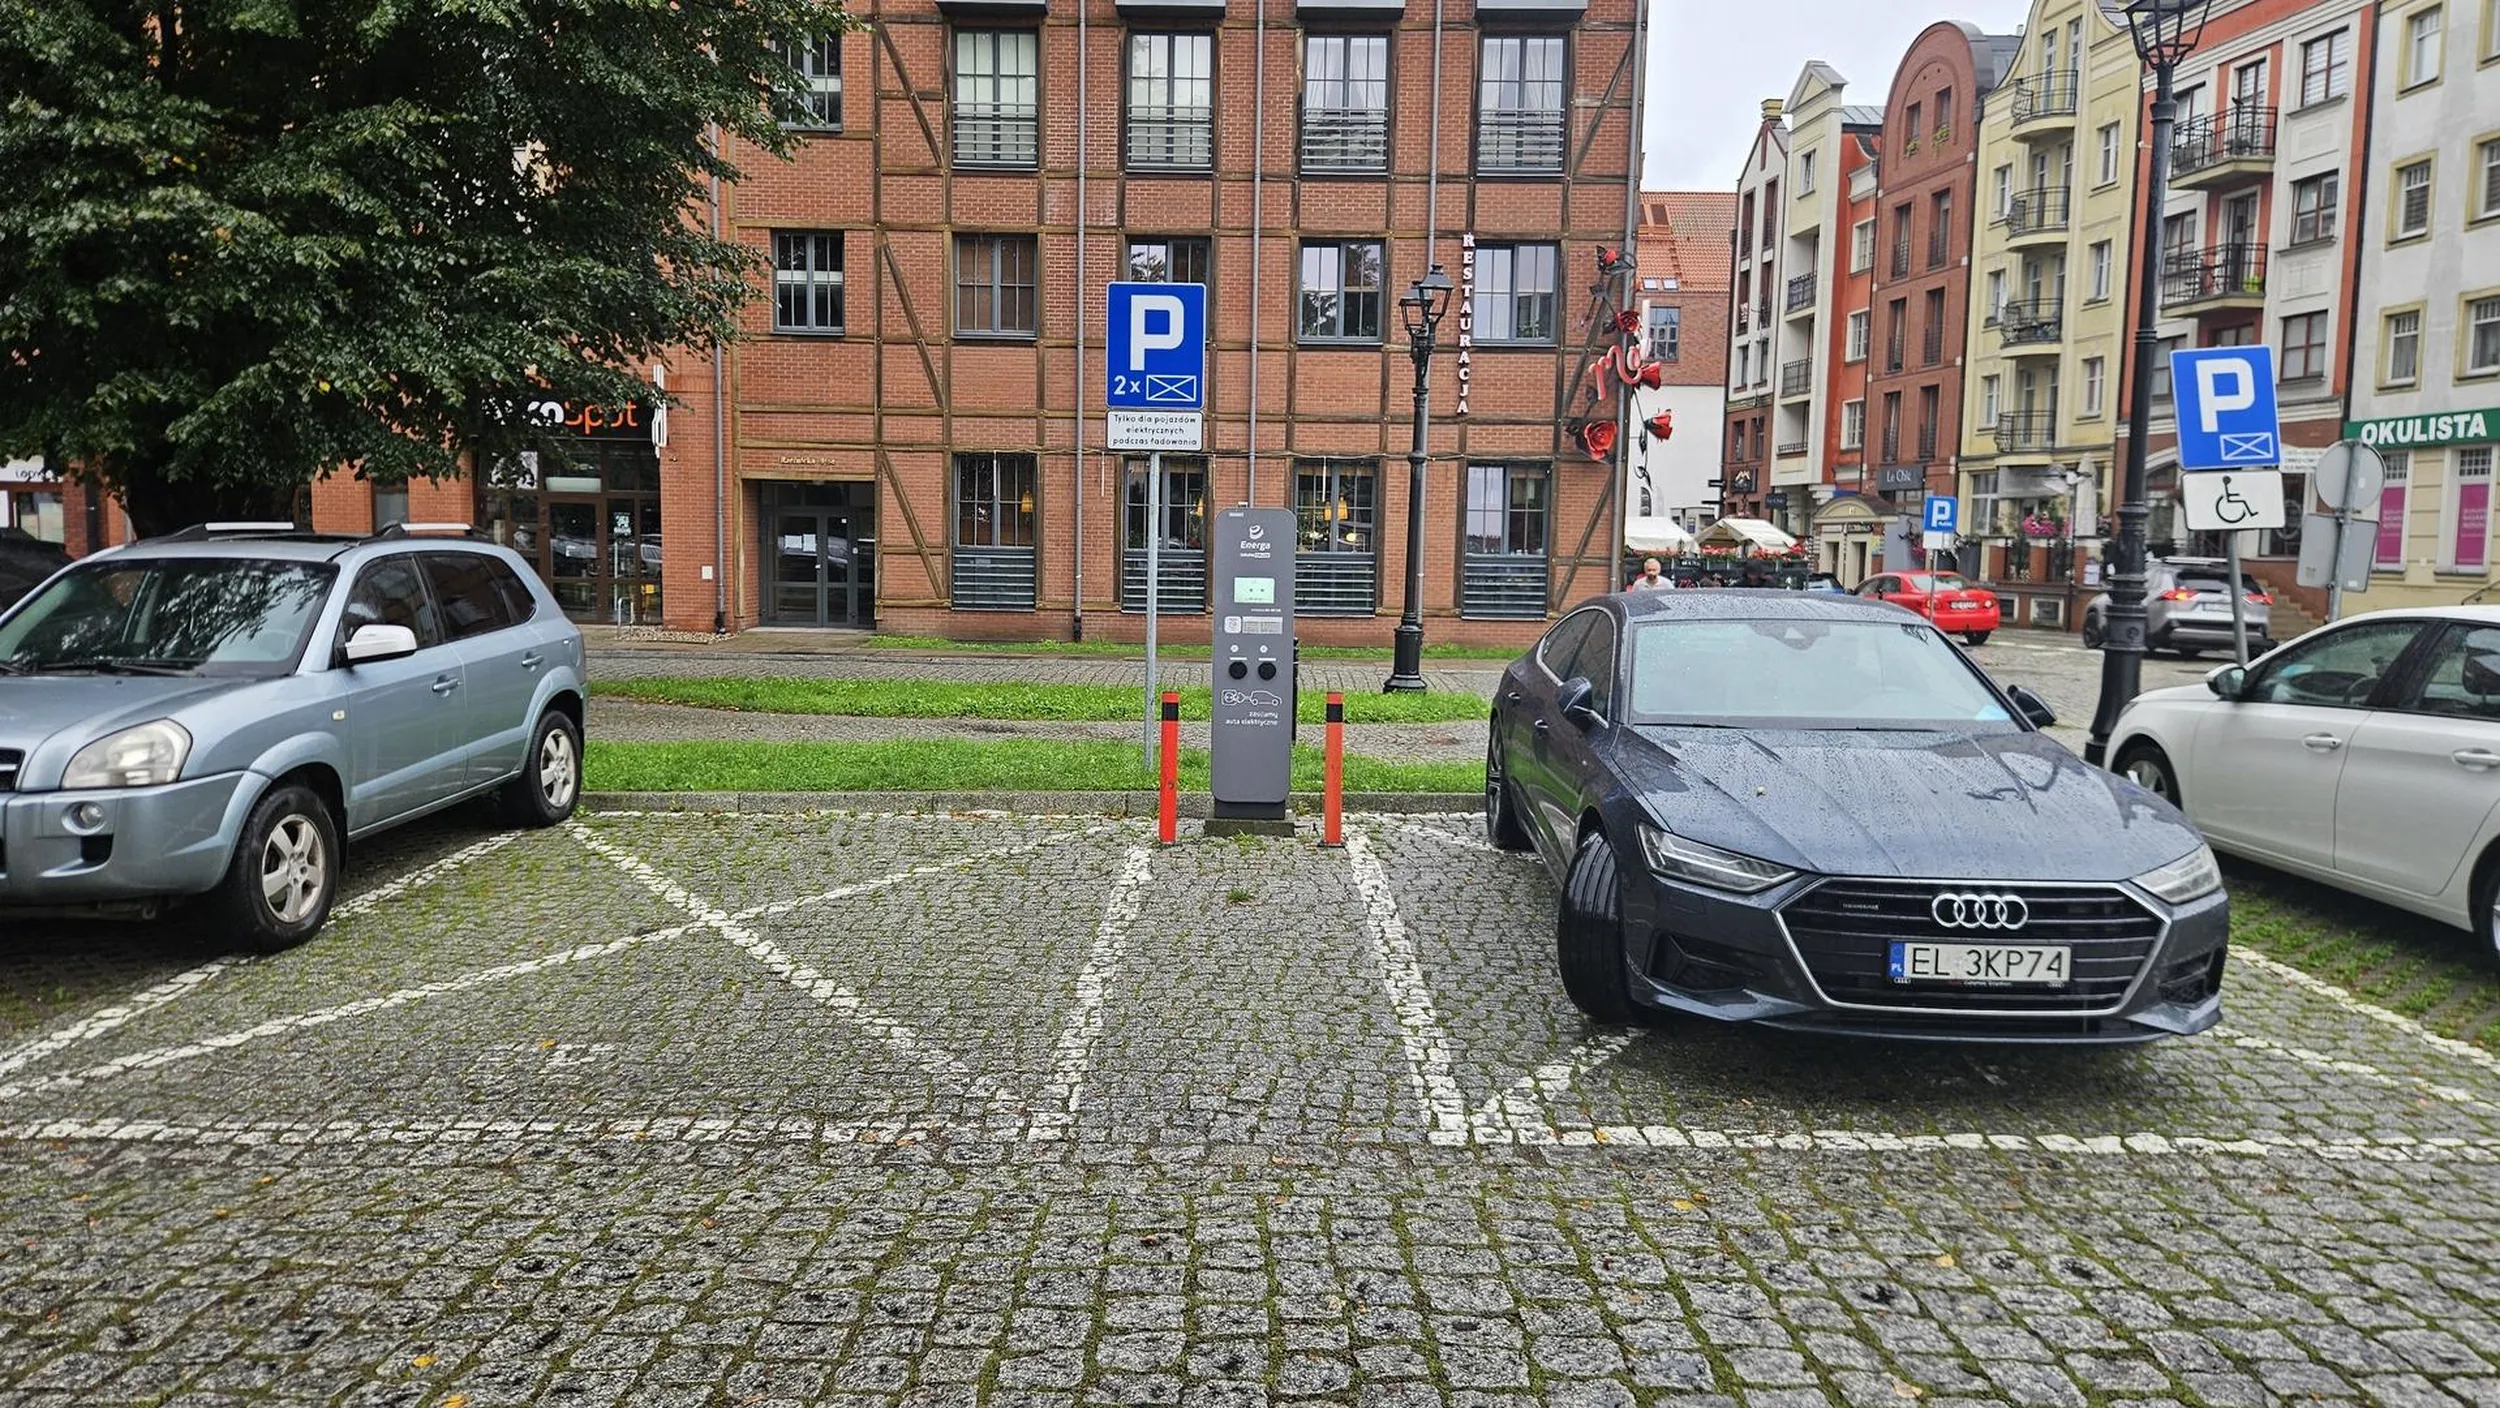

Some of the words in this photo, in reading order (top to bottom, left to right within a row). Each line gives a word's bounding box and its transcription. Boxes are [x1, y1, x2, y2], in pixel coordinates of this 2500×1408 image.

[1129, 295, 1185, 371] P
[1457, 232, 1475, 414] RESTAURACJA
[2195, 357, 2256, 433] P
[1114, 415, 1136, 424] Tylko
[1138, 414, 1152, 422] dla
[1154, 415, 1196, 424] pojazdów
[1126, 427, 1184, 436] elektrycznych
[2361, 412, 2487, 446] OKULISTA
[1113, 437, 1148, 446] podczas
[1150, 437, 1197, 446] ładowania
[1931, 500, 1951, 528] P
[1240, 540, 1271, 551] Energa
[1911, 947, 1950, 976] EL
[1966, 949, 2064, 979] 3KP74
